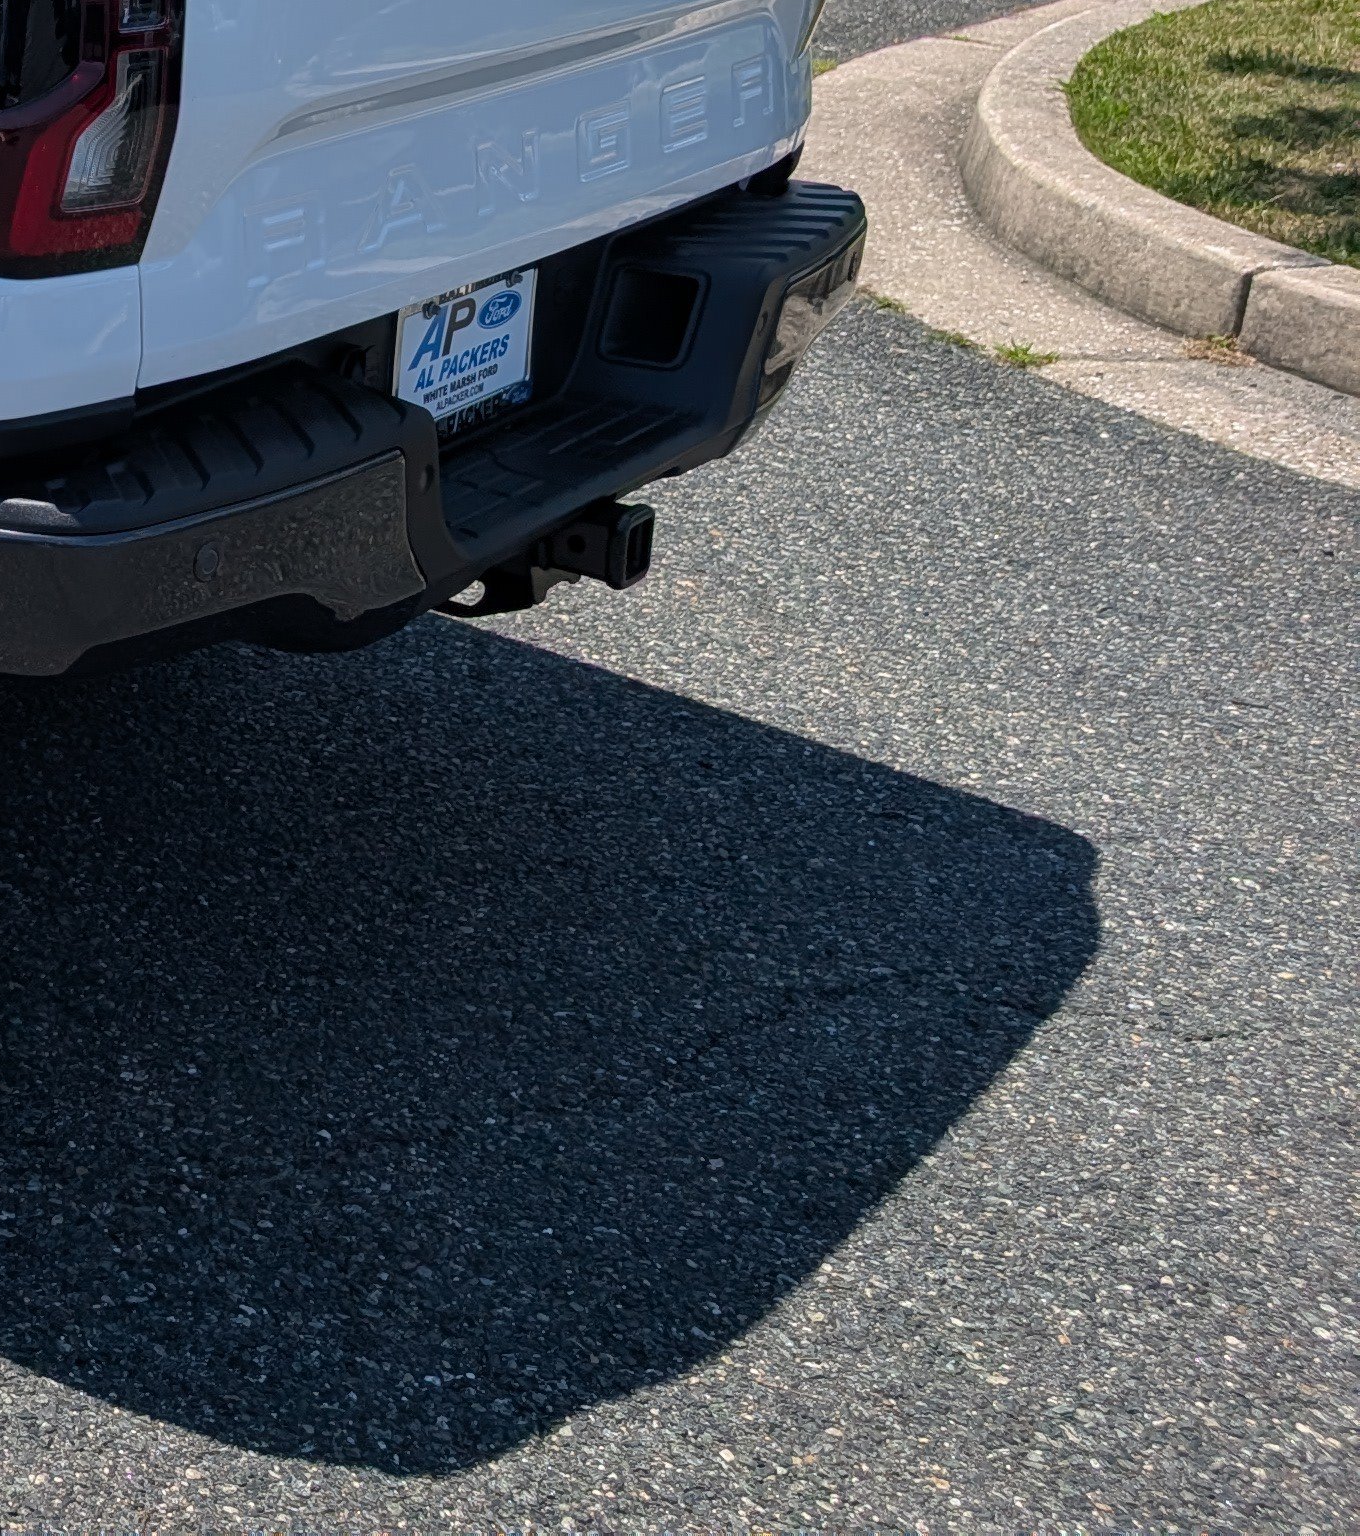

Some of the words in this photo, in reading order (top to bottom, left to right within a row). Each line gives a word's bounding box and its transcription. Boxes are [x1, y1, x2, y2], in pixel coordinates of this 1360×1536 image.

[244, 52, 775, 288] RANGER
[407, 297, 477, 371] AP
[413, 365, 435, 393] AL
[438, 333, 511, 383] PACKERS
[422, 386, 448, 404] WHITE
[449, 374, 477, 393] MARSH
[478, 363, 499, 380] FORD
[435, 382, 485, 413] ALPACKER.COM
